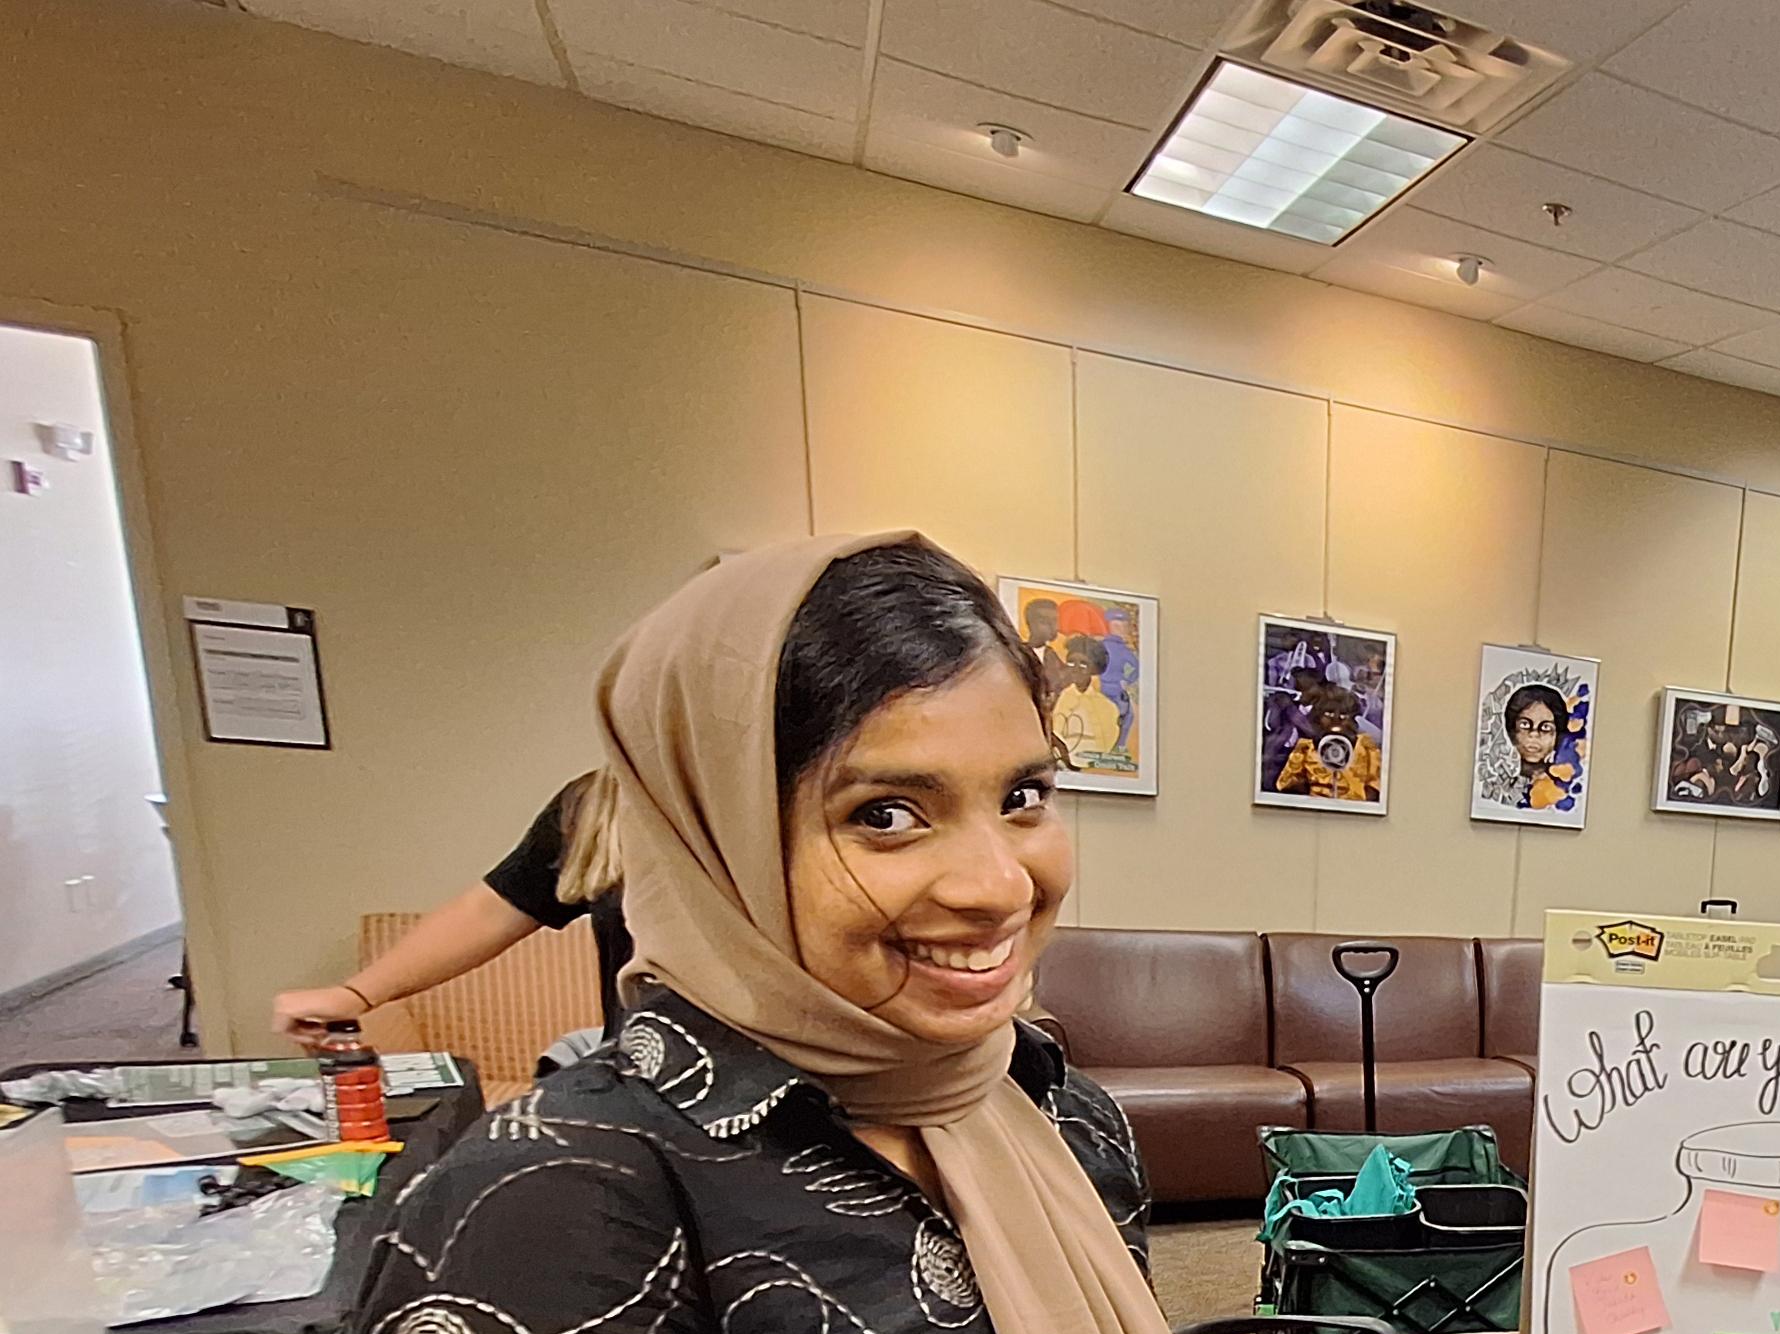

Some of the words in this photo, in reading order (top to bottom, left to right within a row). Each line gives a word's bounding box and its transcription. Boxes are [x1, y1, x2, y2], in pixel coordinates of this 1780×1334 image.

[1609, 932, 1657, 947] Post-it
[1543, 1010, 1668, 1144] What
[1684, 1039, 1751, 1082] are
